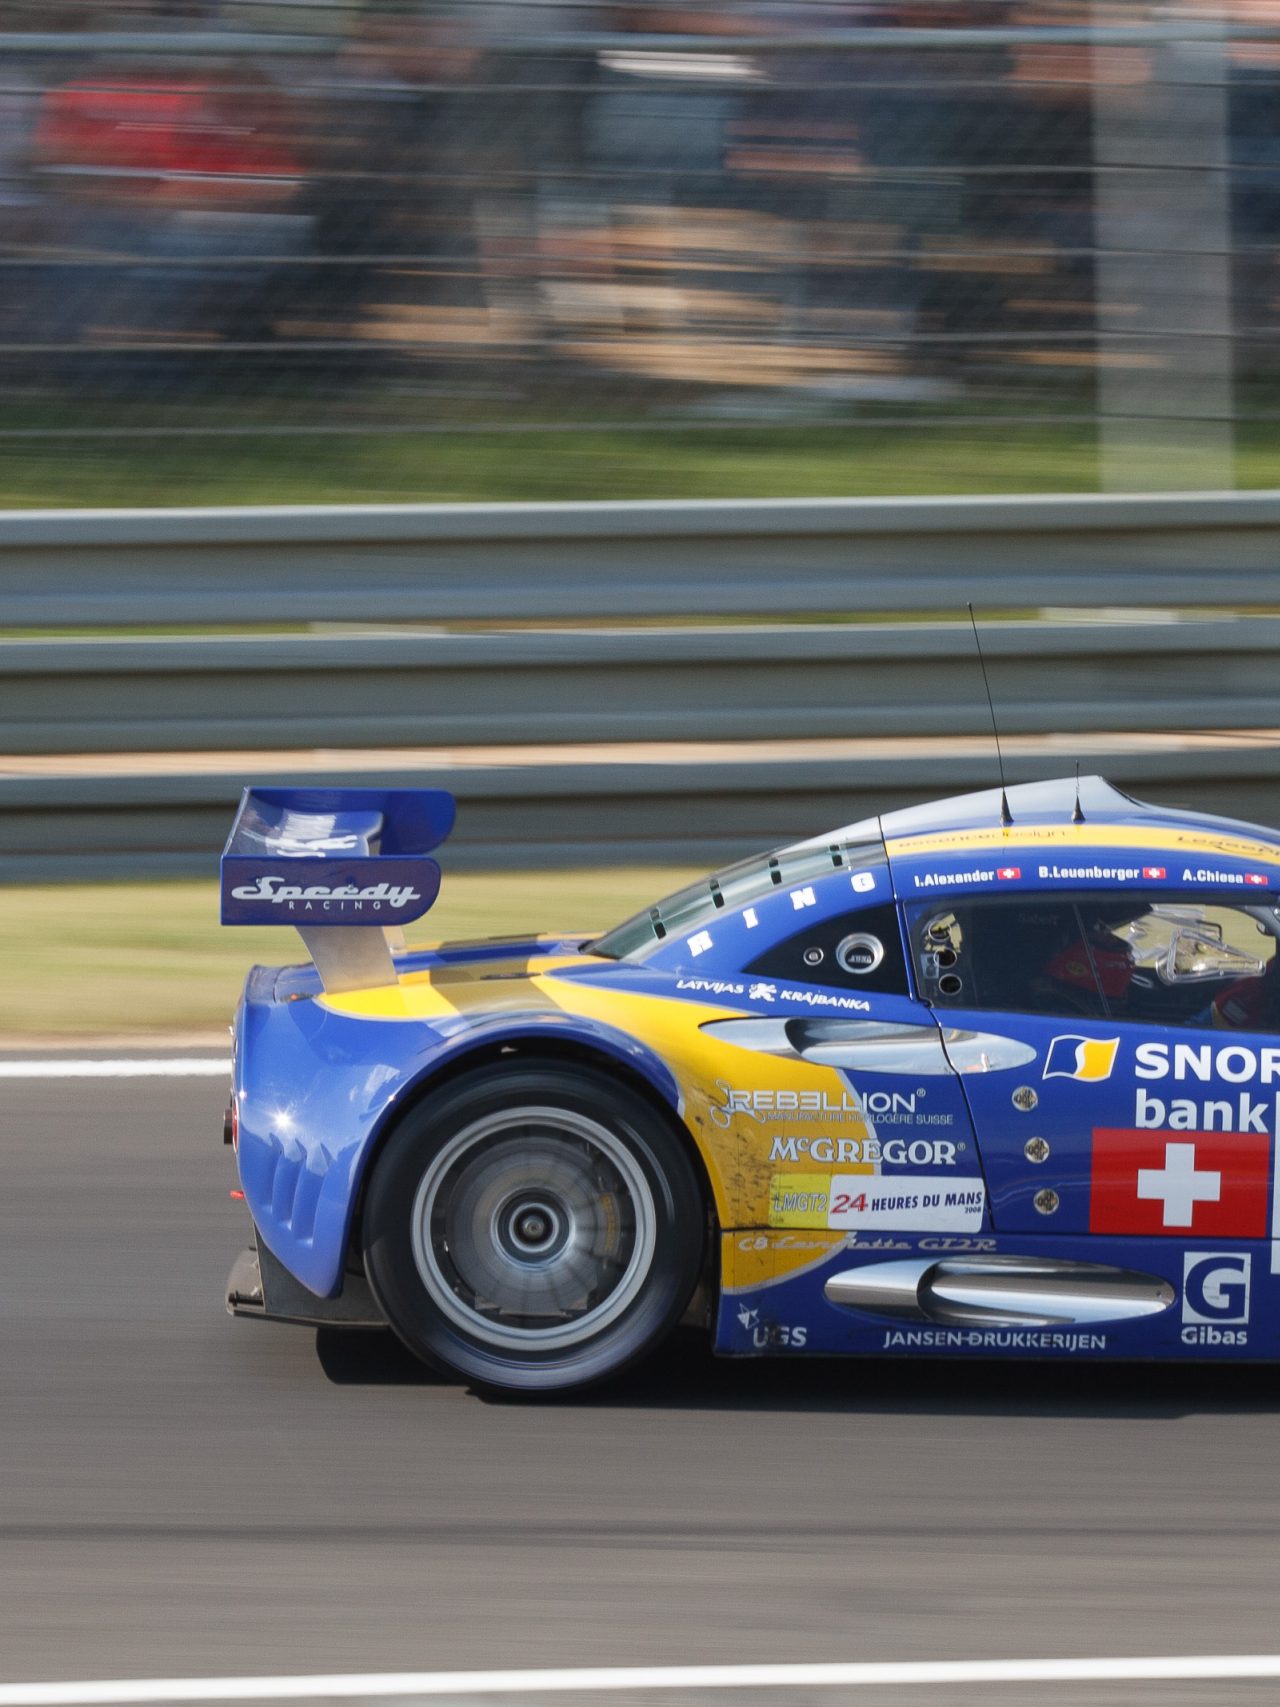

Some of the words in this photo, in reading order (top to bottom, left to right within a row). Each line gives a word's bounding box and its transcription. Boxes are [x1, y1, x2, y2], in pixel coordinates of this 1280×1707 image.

[915, 869, 995, 887] I.Alexander
[1038, 865, 1140, 879] B.Leuenberger
[1182, 869, 1244, 885] A.Chiesa
[231, 876, 421, 908] Speedy
[288, 901, 382, 910] RACING
[676, 980, 744, 994] LATVIJAS
[1135, 1088, 1270, 1133] bank
[916, 1114, 953, 1125] SUISSE
[830, 1193, 869, 1214] 24
[871, 1196, 918, 1212] HEURES
[922, 1194, 940, 1208] DU
[944, 1192, 982, 1206] MANS
[964, 1206, 982, 1215] 2008
[1181, 1325, 1248, 1346] Gibas
